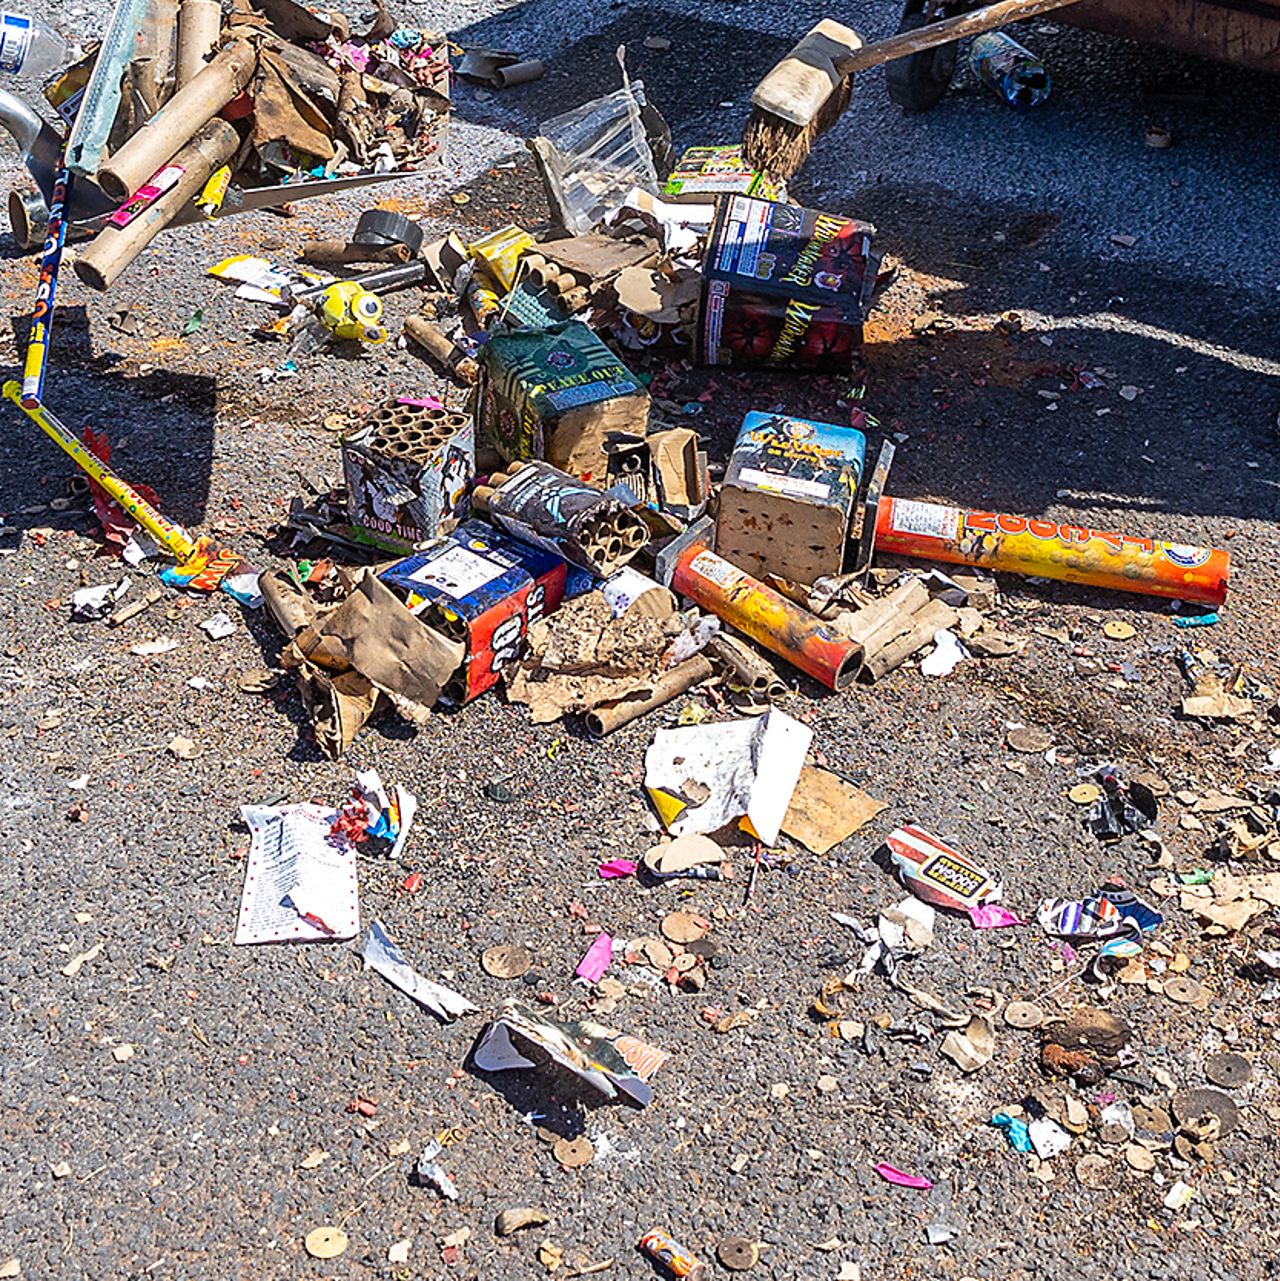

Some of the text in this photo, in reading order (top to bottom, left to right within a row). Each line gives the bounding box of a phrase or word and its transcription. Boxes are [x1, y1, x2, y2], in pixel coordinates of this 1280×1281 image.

[363, 514, 425, 542] GOOD TIME
[931, 861, 979, 890] 500GM
